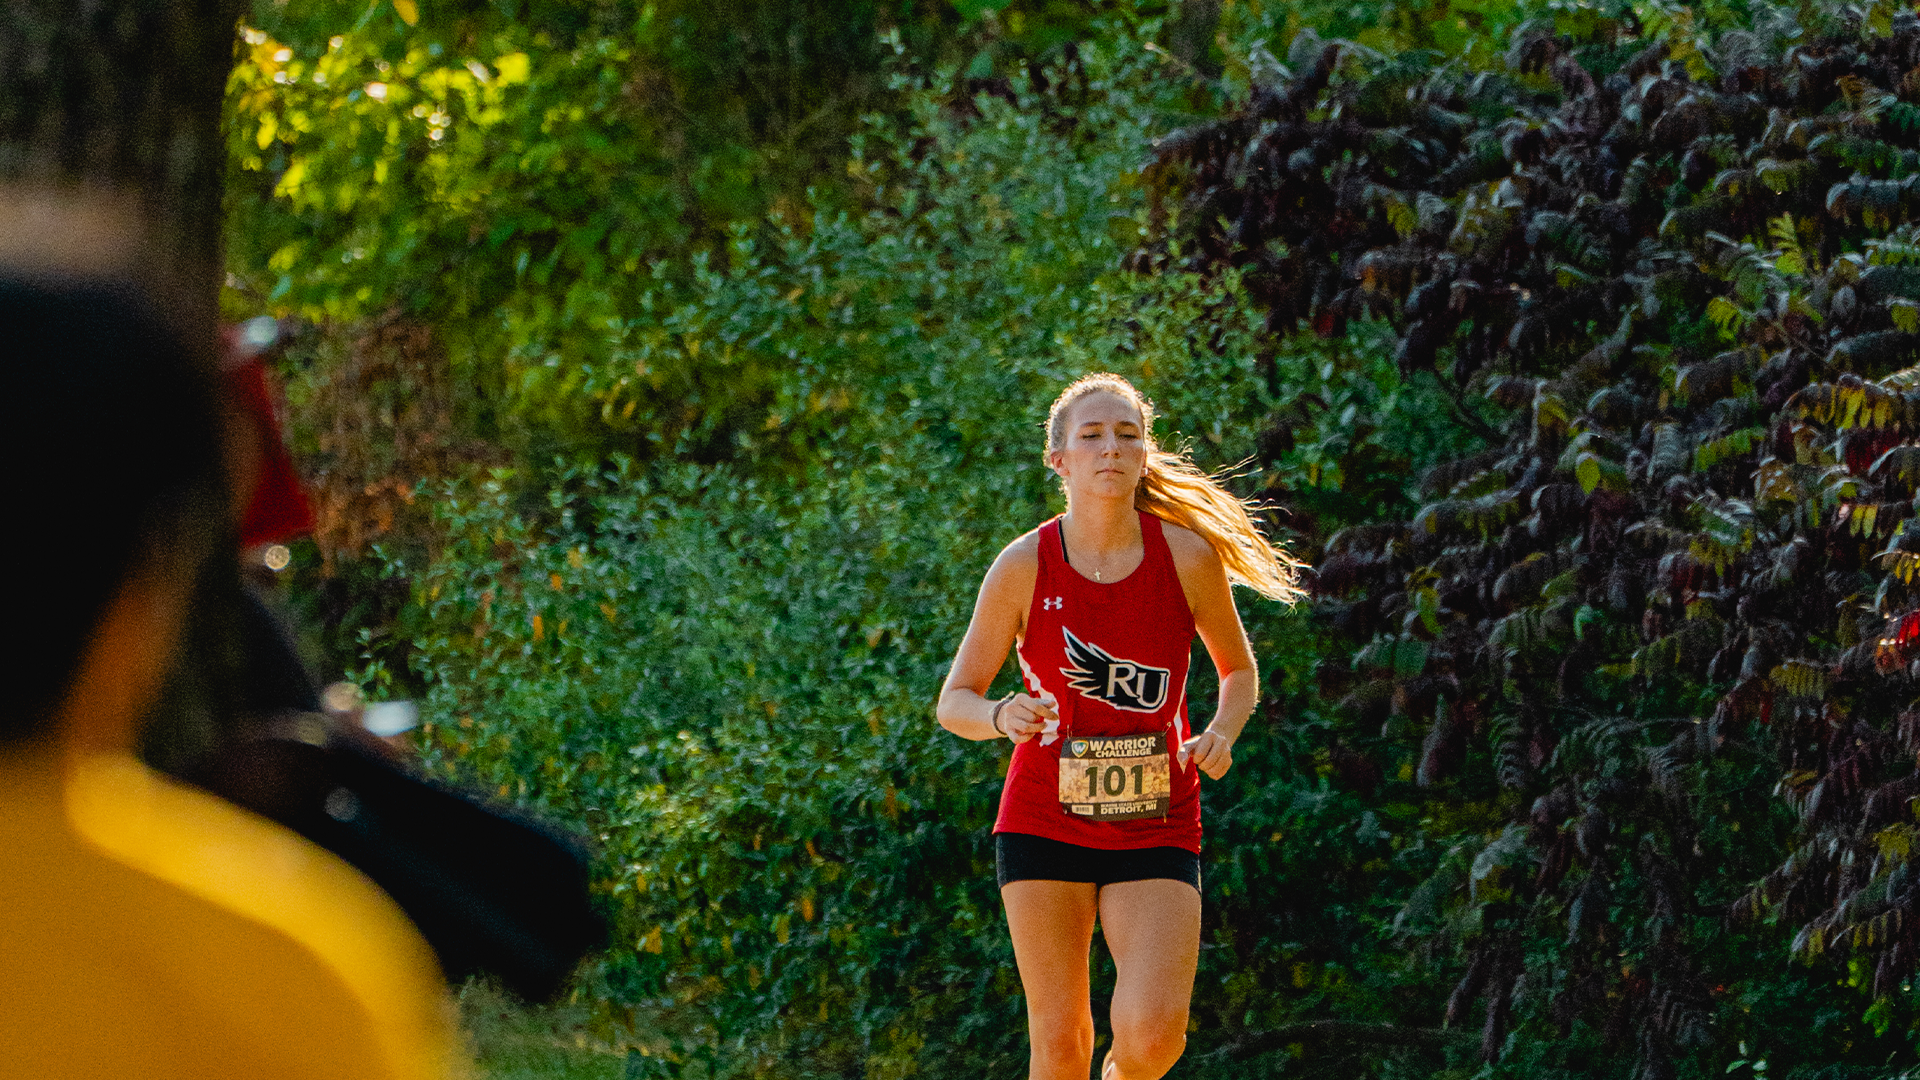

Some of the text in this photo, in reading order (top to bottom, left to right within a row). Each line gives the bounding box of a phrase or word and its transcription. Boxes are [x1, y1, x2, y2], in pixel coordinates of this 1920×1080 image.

[1106, 663, 1167, 708] RU
[1089, 737, 1156, 752] WARRIOR
[1095, 747, 1152, 758] CHALLENGE
[1085, 764, 1143, 797] 101
[1101, 805, 1144, 815] DETROIT,
[1145, 803, 1157, 811] MI
